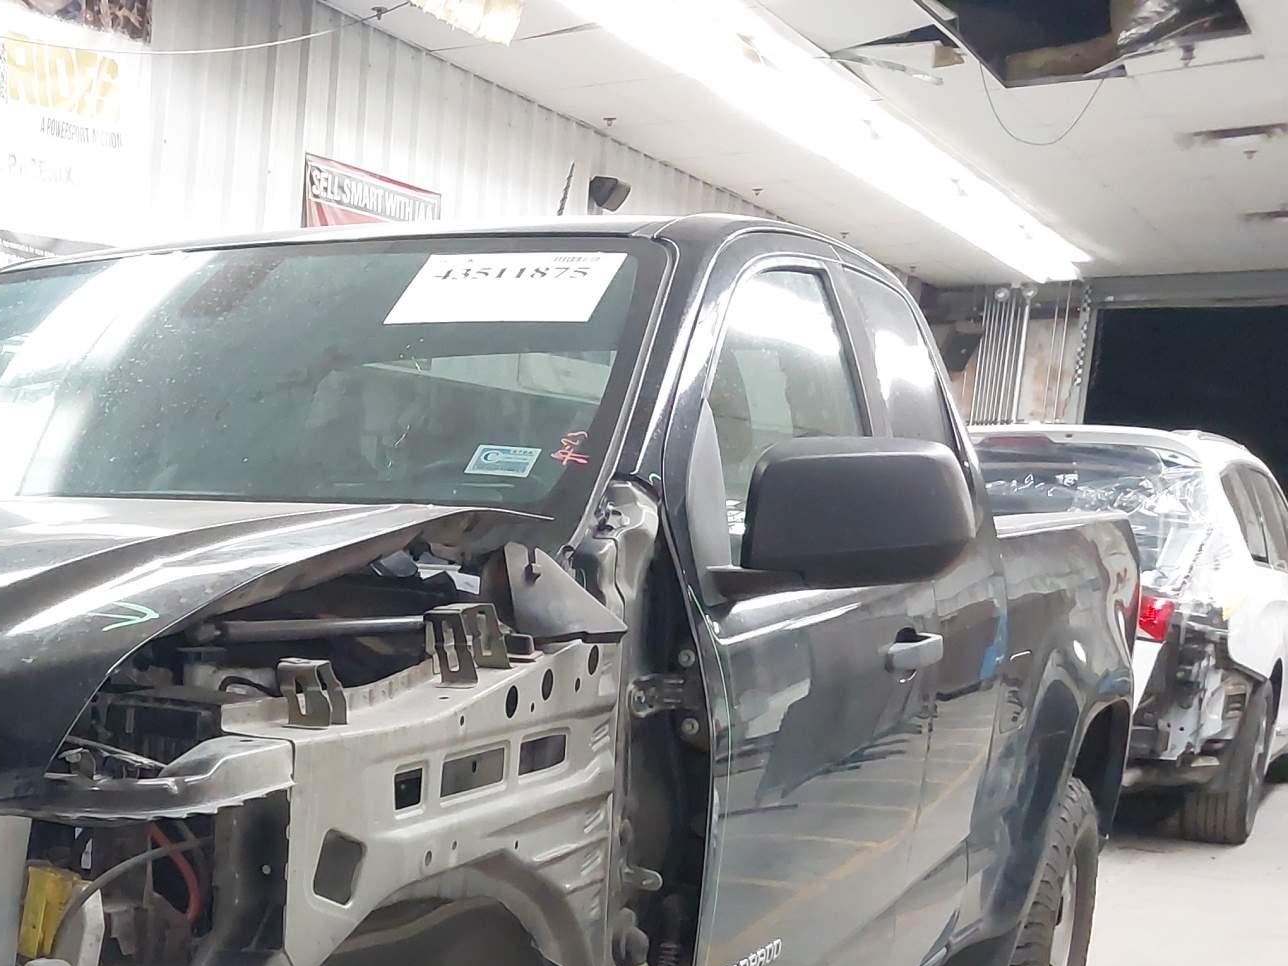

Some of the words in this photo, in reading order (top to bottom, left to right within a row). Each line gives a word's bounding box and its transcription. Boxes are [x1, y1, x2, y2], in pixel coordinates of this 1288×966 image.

[47, 117, 90, 145] POWERSPORT
[311, 168, 341, 200] SELL
[343, 179, 385, 214] SMART
[385, 191, 413, 222] WITH
[433, 266, 591, 281] 43511875
